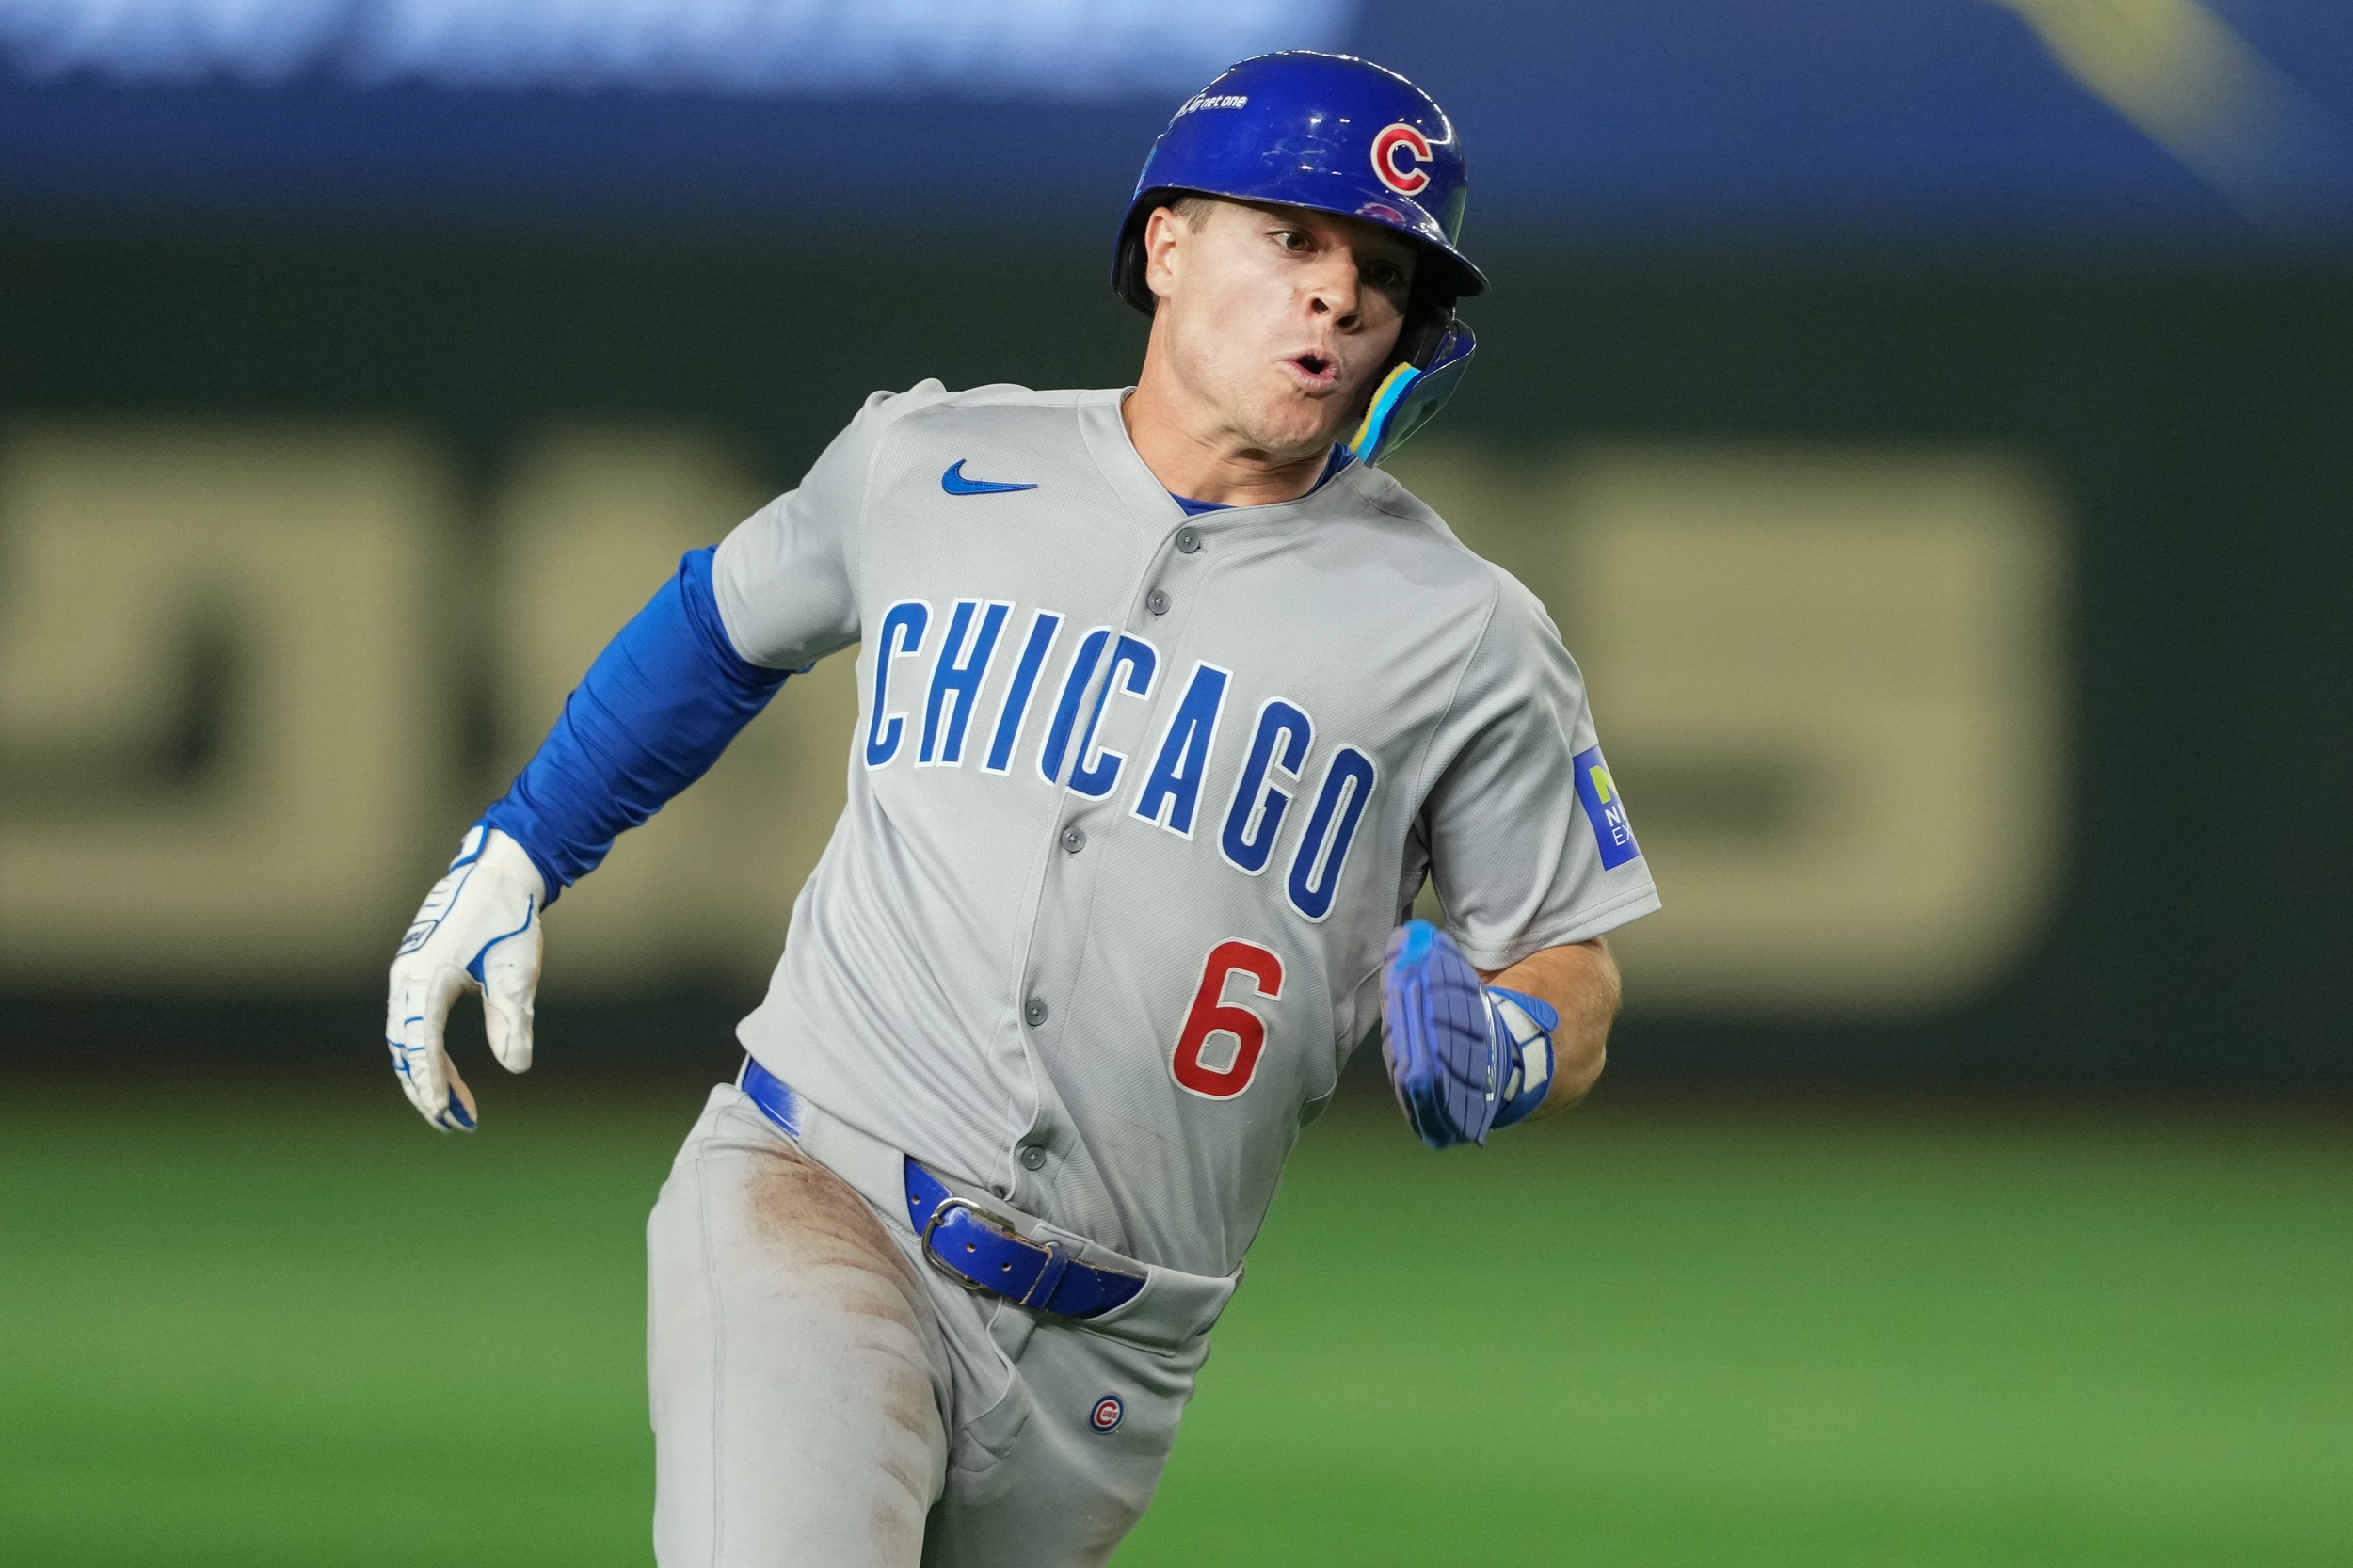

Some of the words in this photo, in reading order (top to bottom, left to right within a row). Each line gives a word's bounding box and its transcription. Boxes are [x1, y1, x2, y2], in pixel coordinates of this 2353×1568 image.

[1370, 123, 1433, 196] C
[863, 598, 1377, 924] CHICAGO
[1169, 936, 1286, 1101] 6
